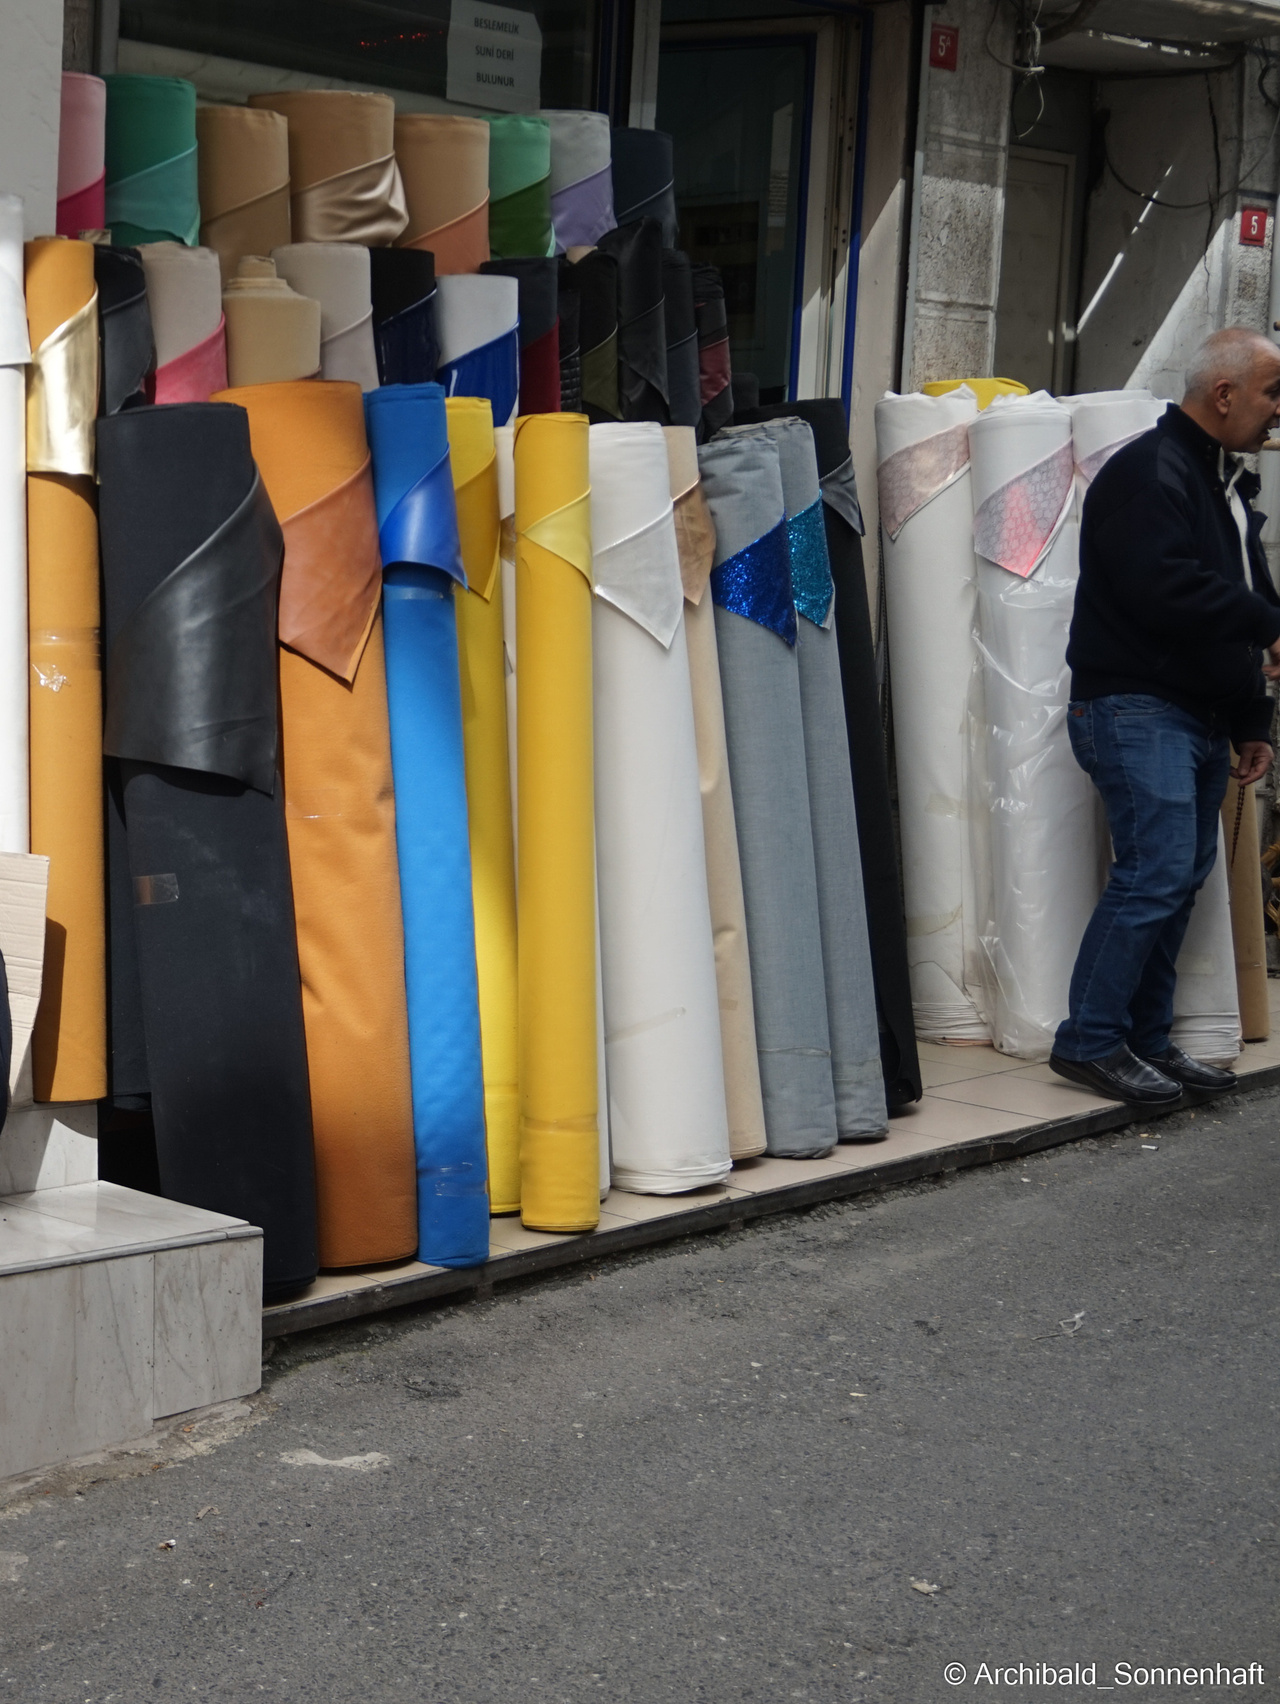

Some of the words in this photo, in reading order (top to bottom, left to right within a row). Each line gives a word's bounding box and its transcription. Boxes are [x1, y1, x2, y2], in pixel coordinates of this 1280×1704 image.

[474, 17, 519, 34] BESLEMELİK
[476, 45, 494, 57] SUNİ
[496, 48, 514, 61] DERİ
[476, 72, 515, 87] BULUNUR
[1251, 215, 1259, 235] 5
